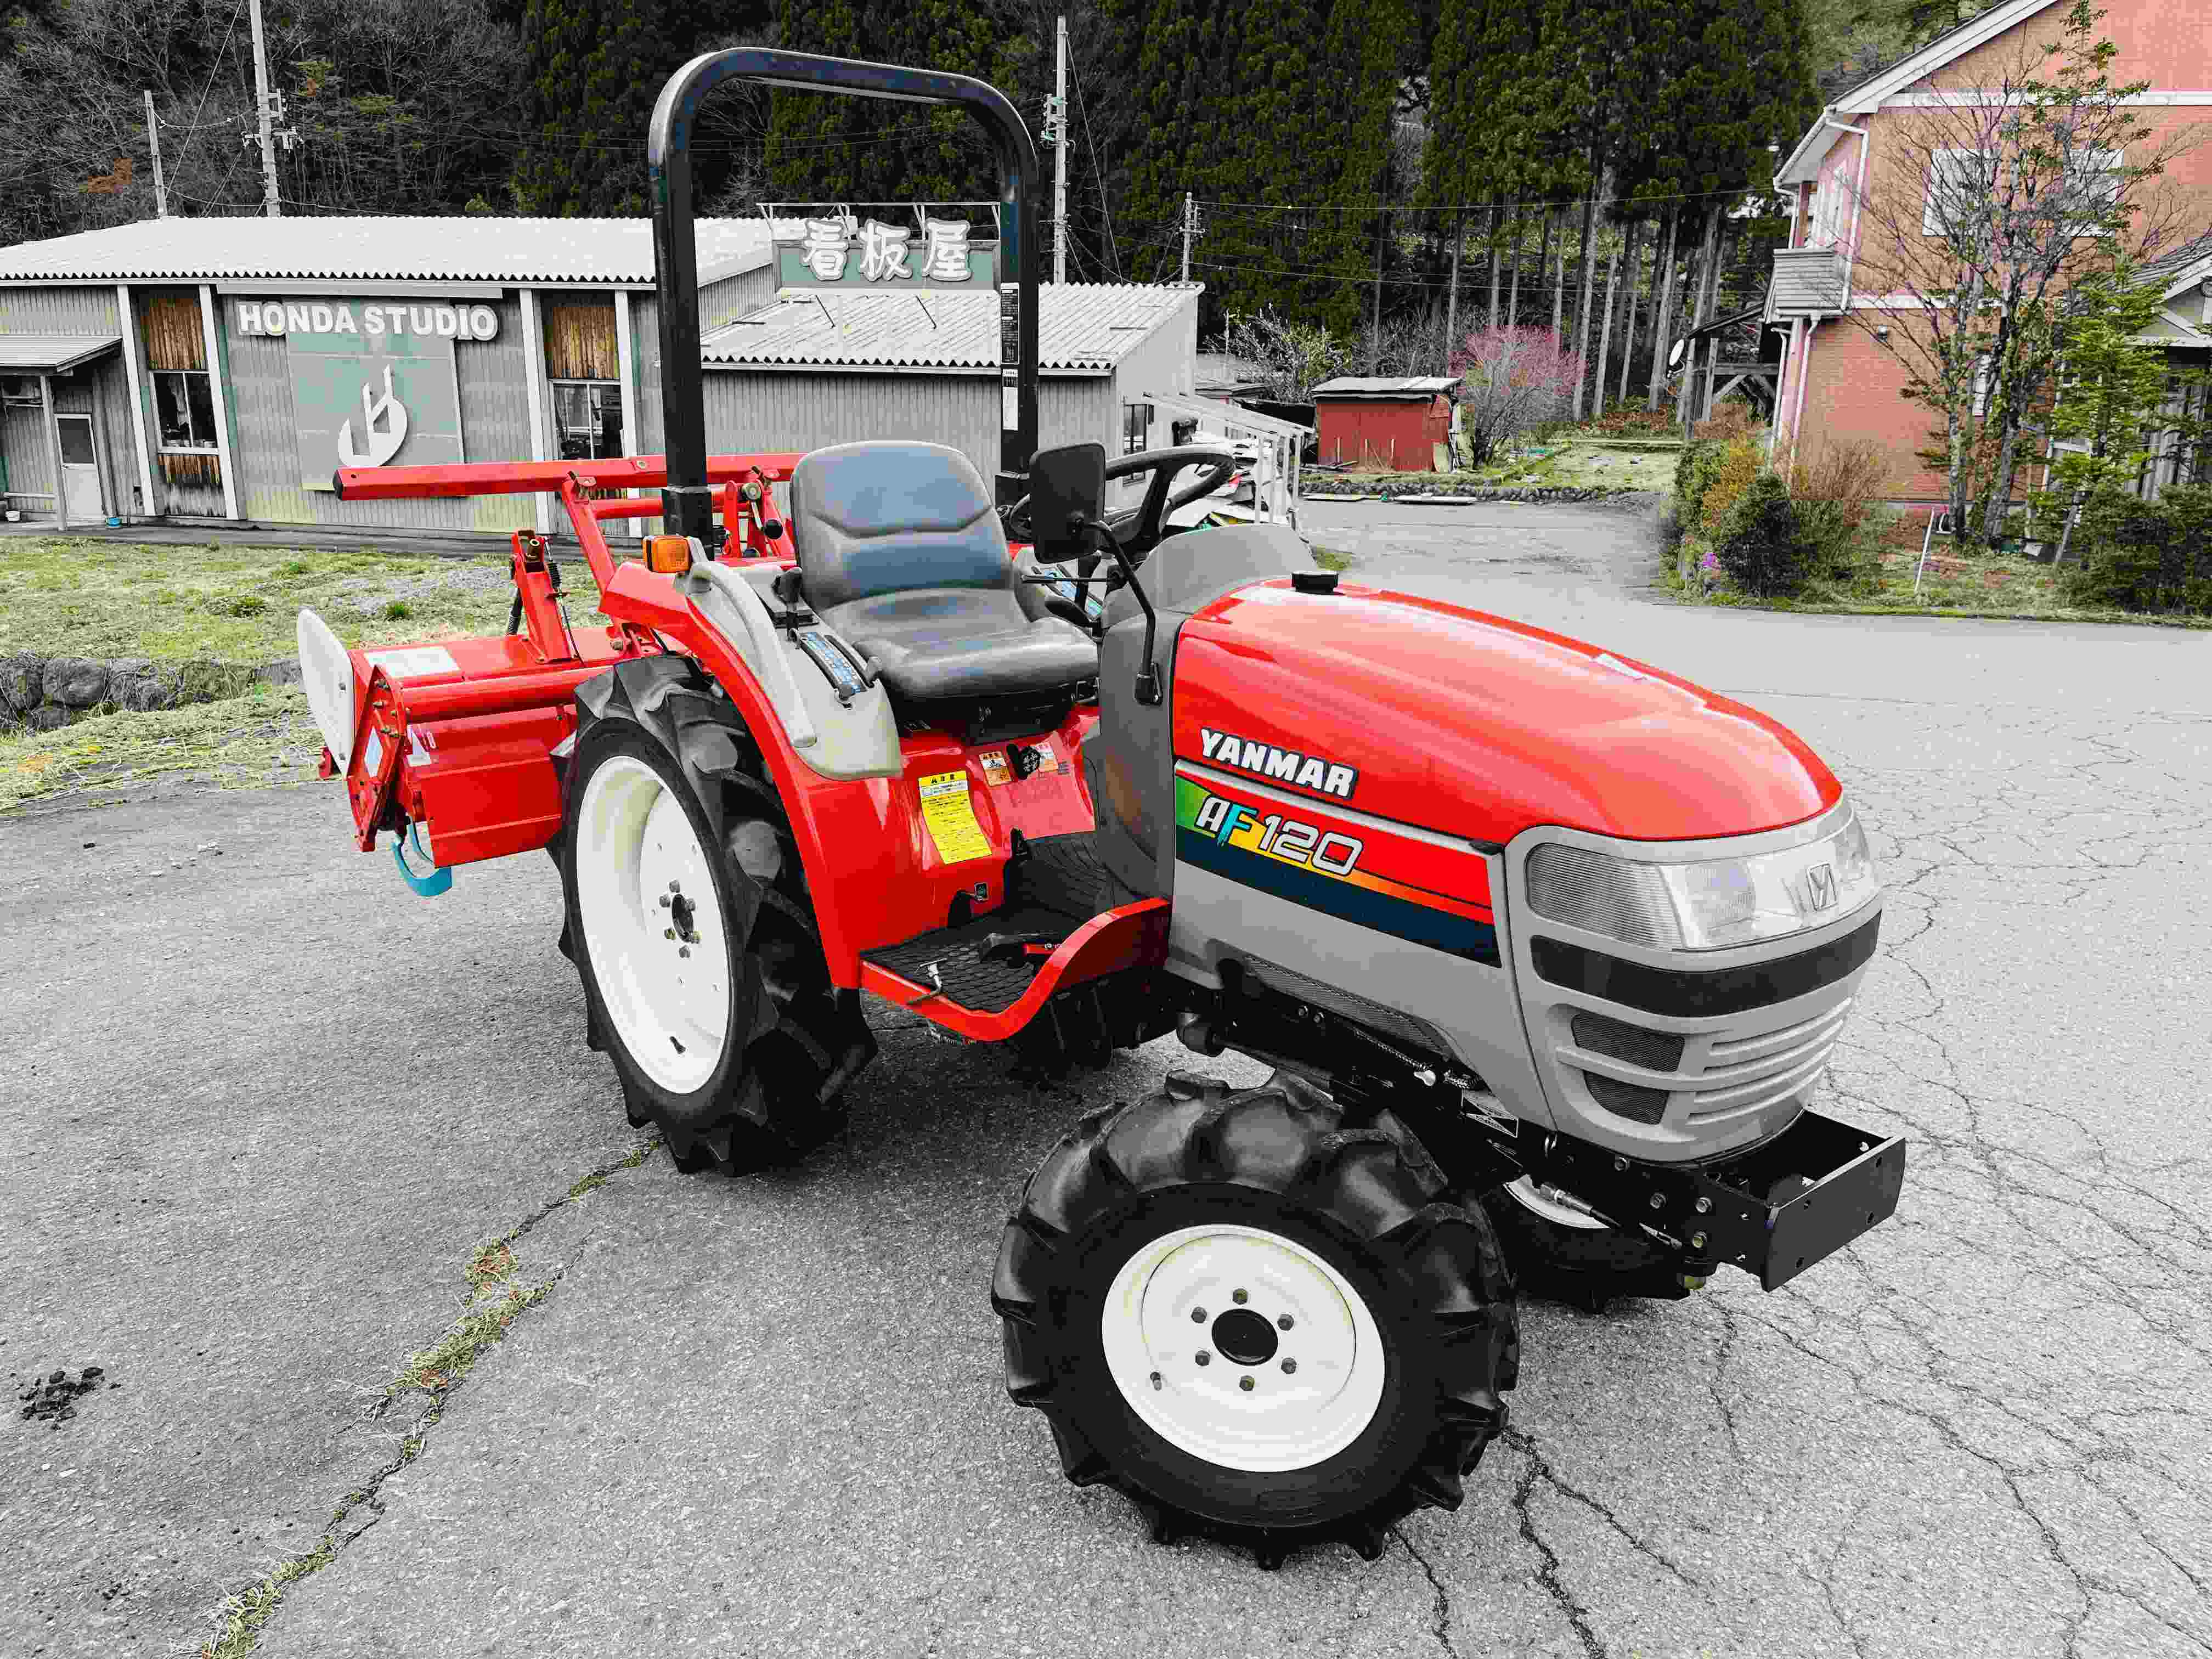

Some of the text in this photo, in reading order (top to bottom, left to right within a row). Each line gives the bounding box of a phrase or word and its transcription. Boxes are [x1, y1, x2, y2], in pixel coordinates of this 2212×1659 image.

[802, 218, 972, 280] 看板屋
[236, 303, 498, 340] HONDA STUDIO
[1200, 728, 1357, 797] YANMAR
